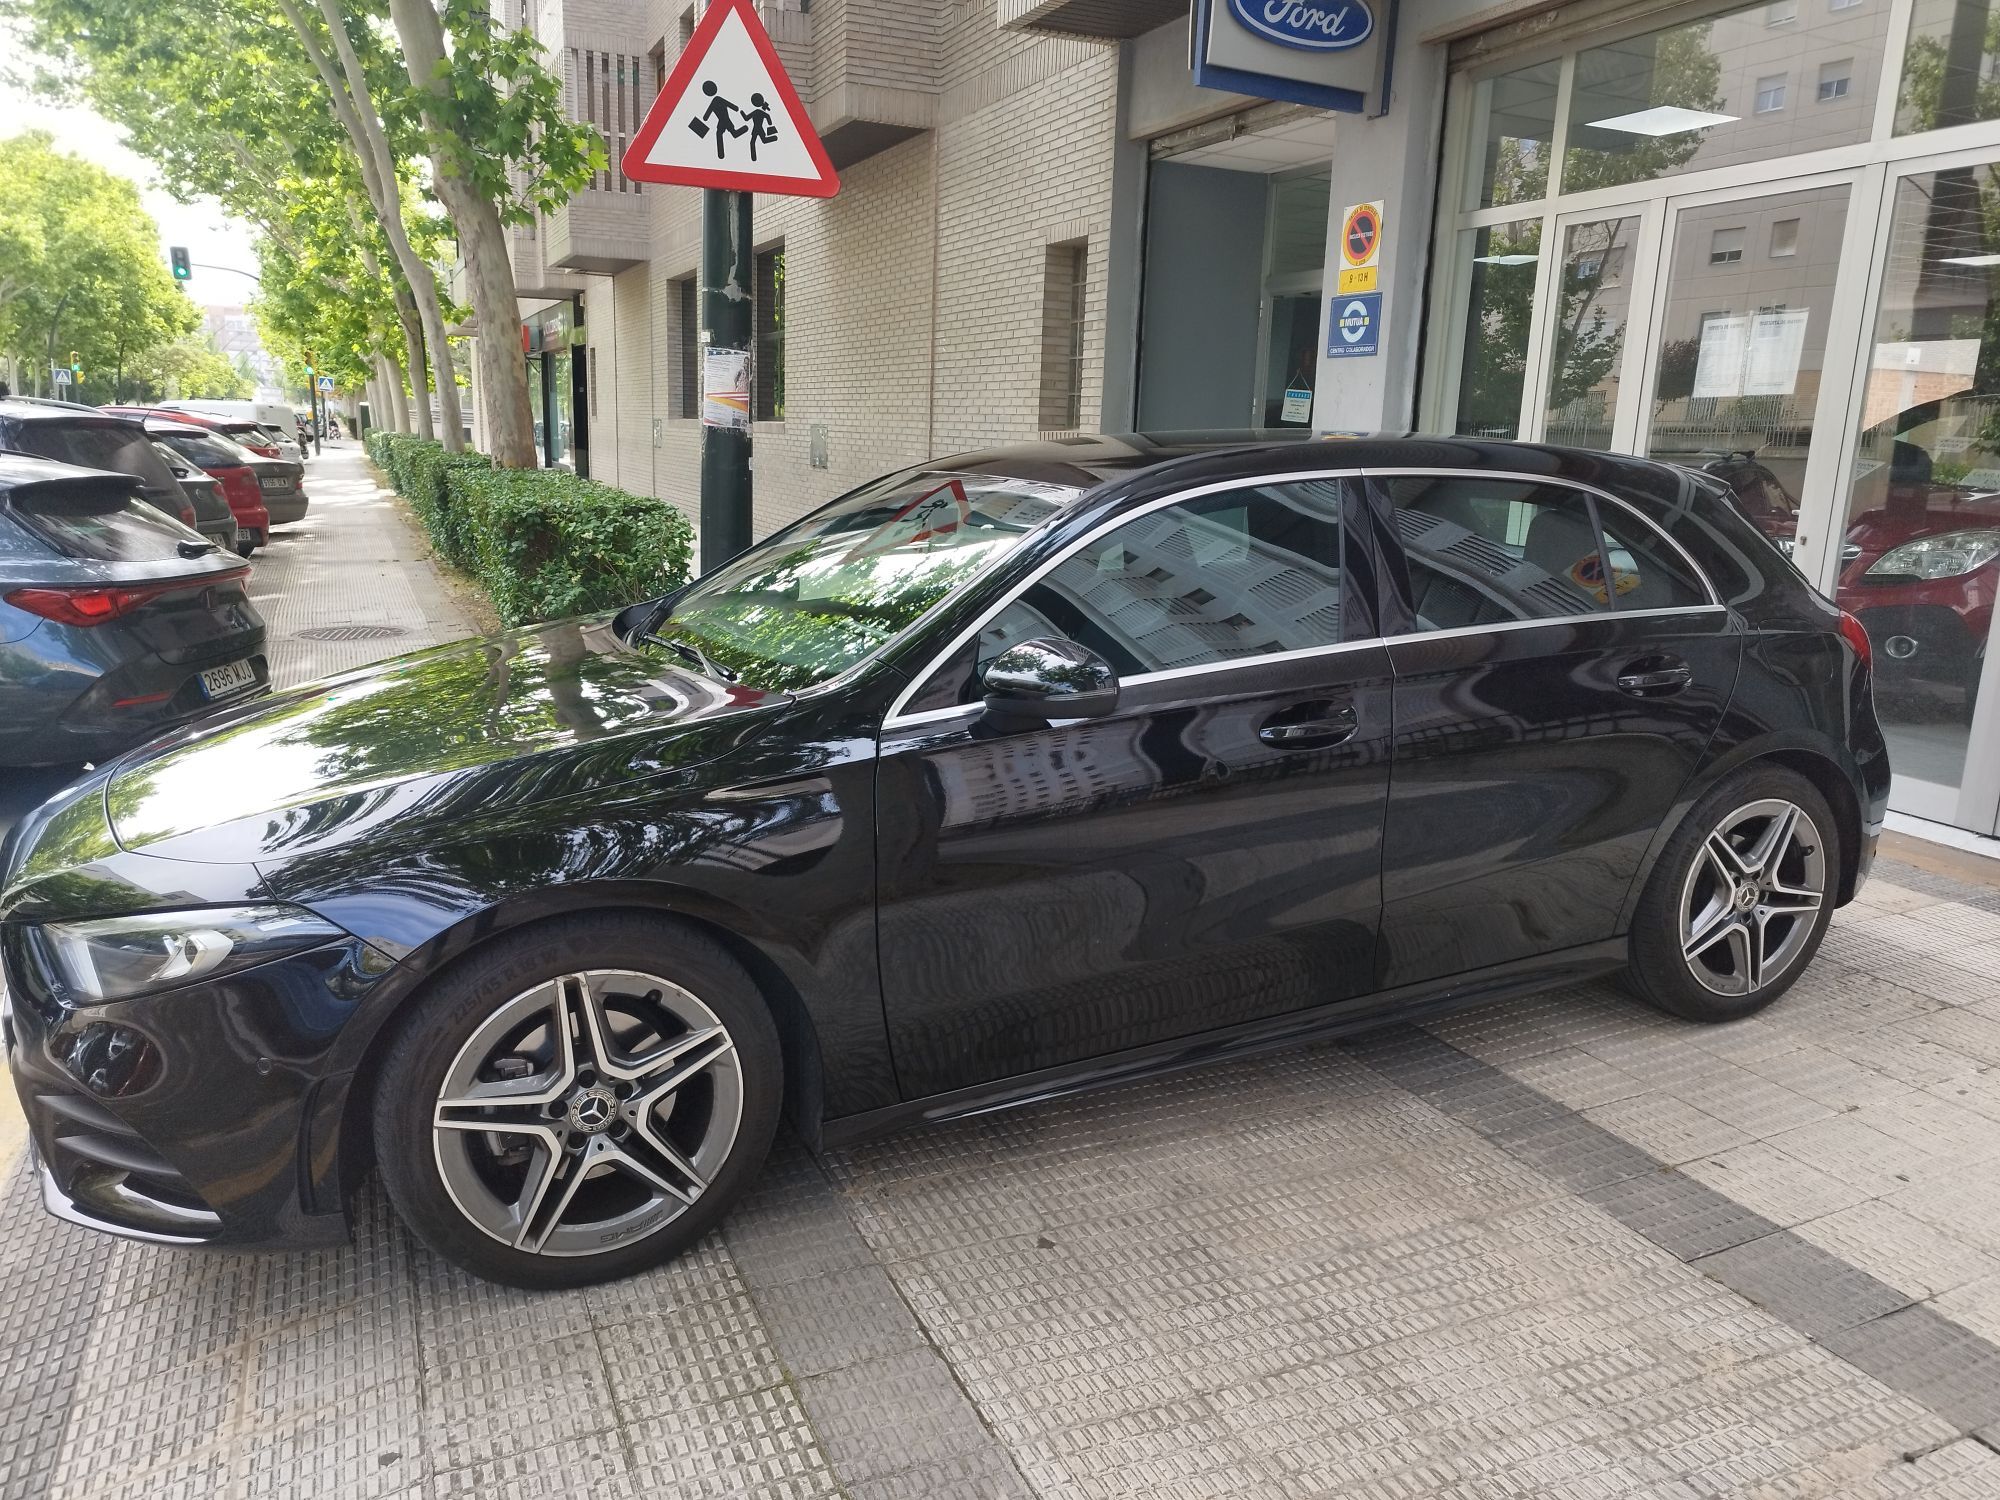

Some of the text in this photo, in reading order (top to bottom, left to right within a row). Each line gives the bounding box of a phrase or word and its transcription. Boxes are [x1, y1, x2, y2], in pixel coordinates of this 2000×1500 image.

[1263, 0, 1350, 36] Ford
[1345, 316, 1363, 327] MUTUA
[1346, 345, 1375, 354] COLABORADOR
[204, 668, 233, 692] 2696
[231, 660, 252, 682] MJJ
